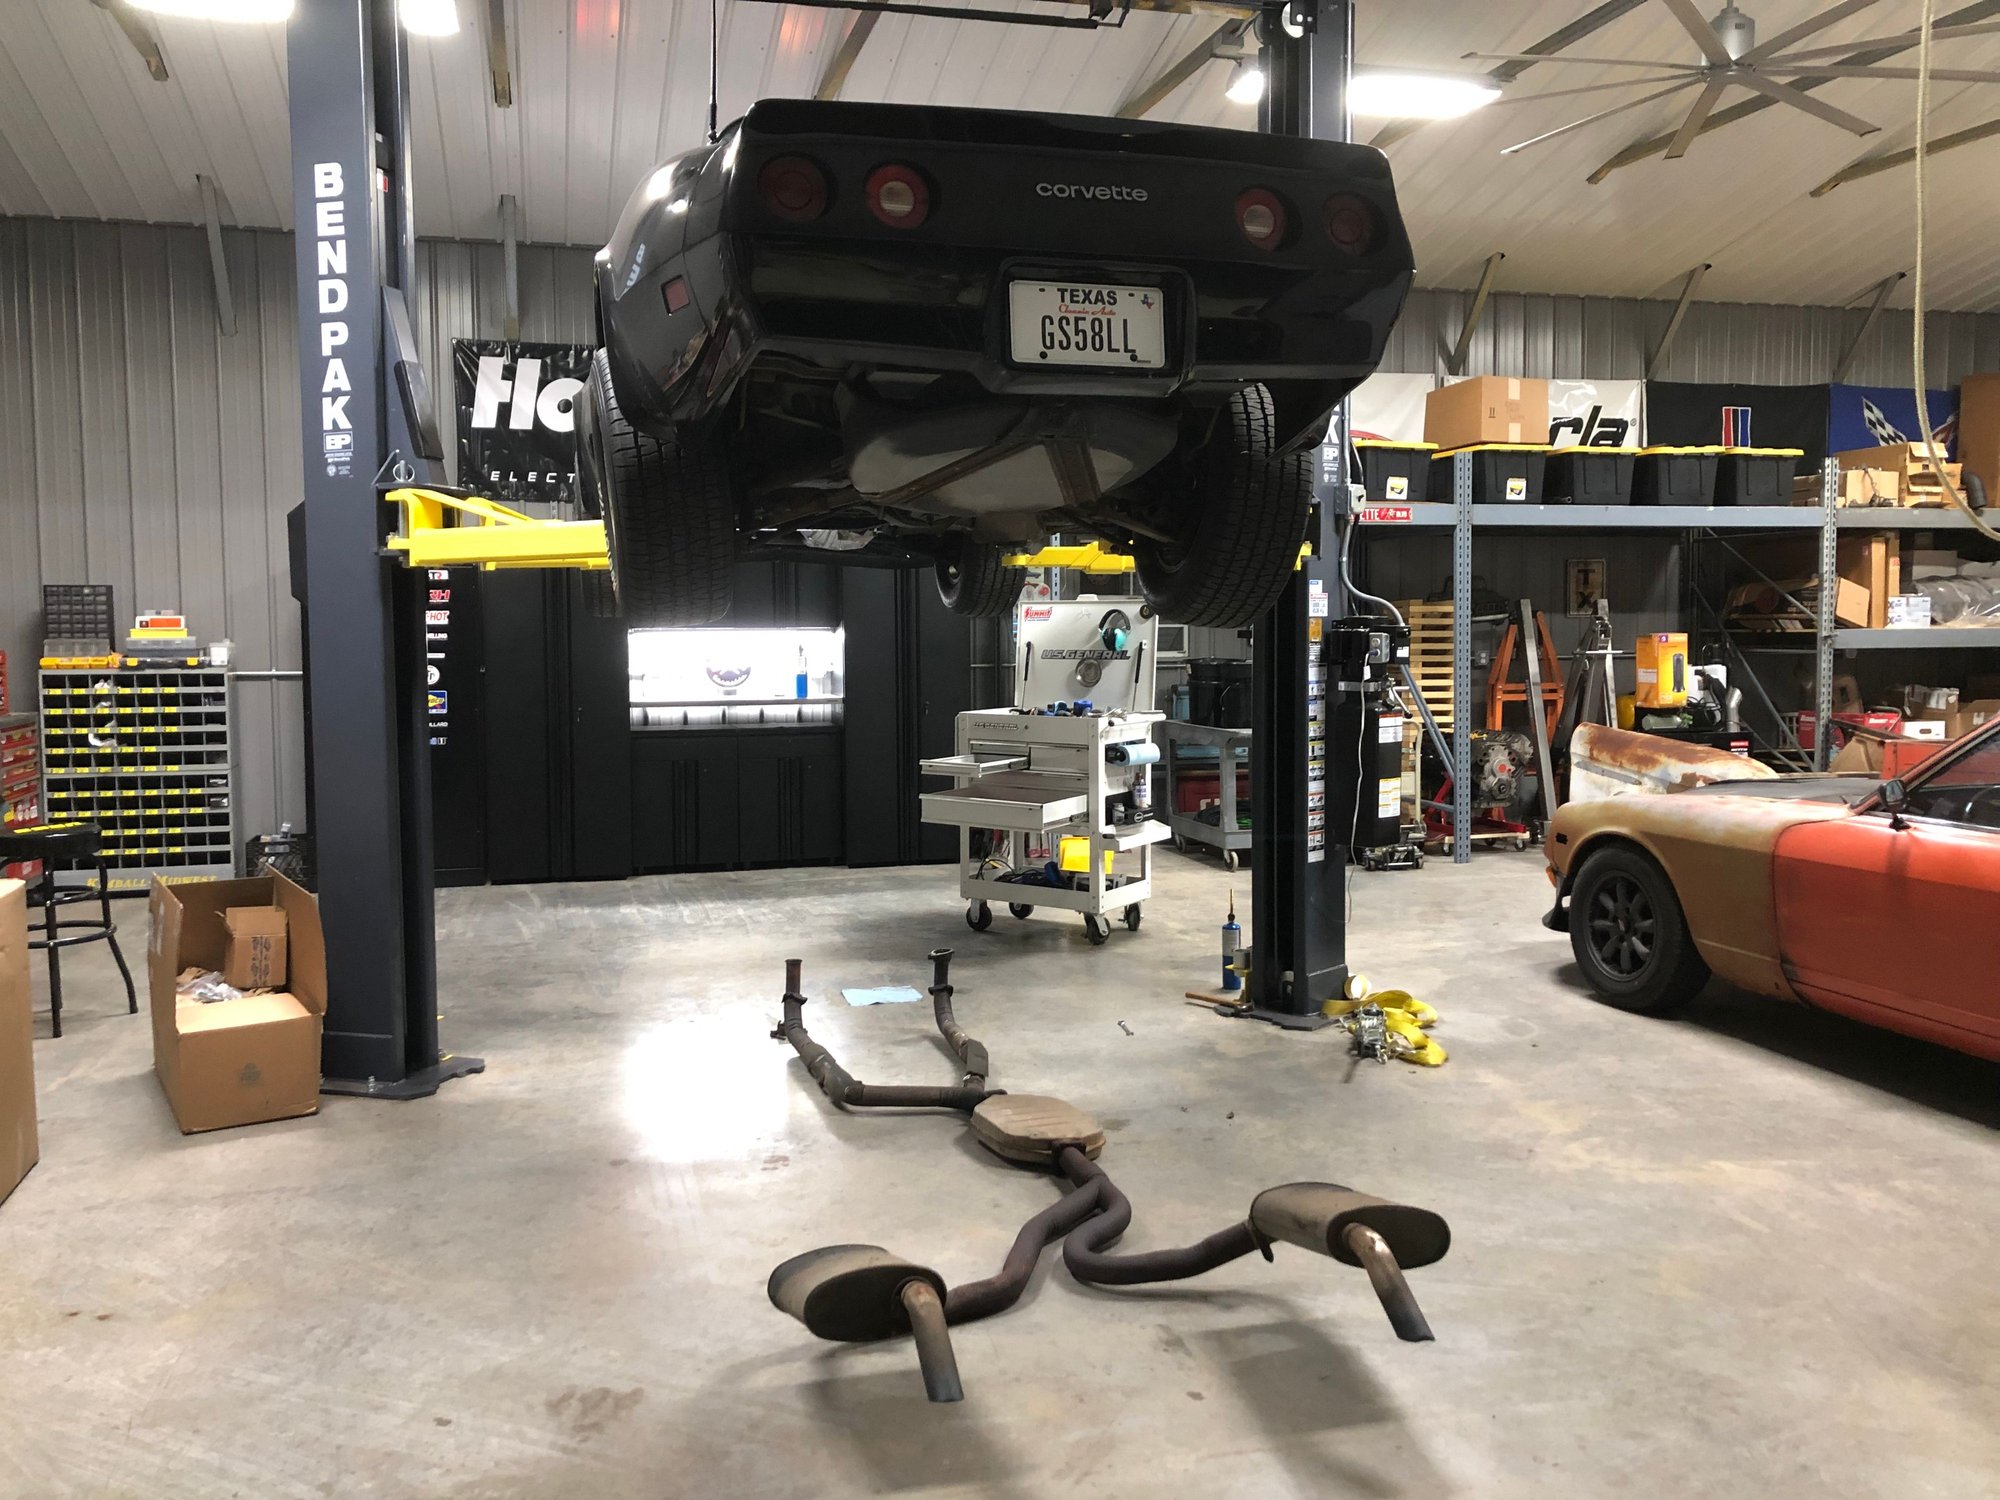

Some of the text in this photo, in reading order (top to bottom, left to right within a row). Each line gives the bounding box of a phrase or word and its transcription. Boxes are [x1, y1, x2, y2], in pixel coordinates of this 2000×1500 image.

[1036, 182, 1148, 202] corvette
[314, 162, 352, 430] BENDPAK
[1057, 287, 1118, 306] TEXAS
[1091, 306, 1117, 317] Auto
[1041, 314, 1137, 354] GS58LL
